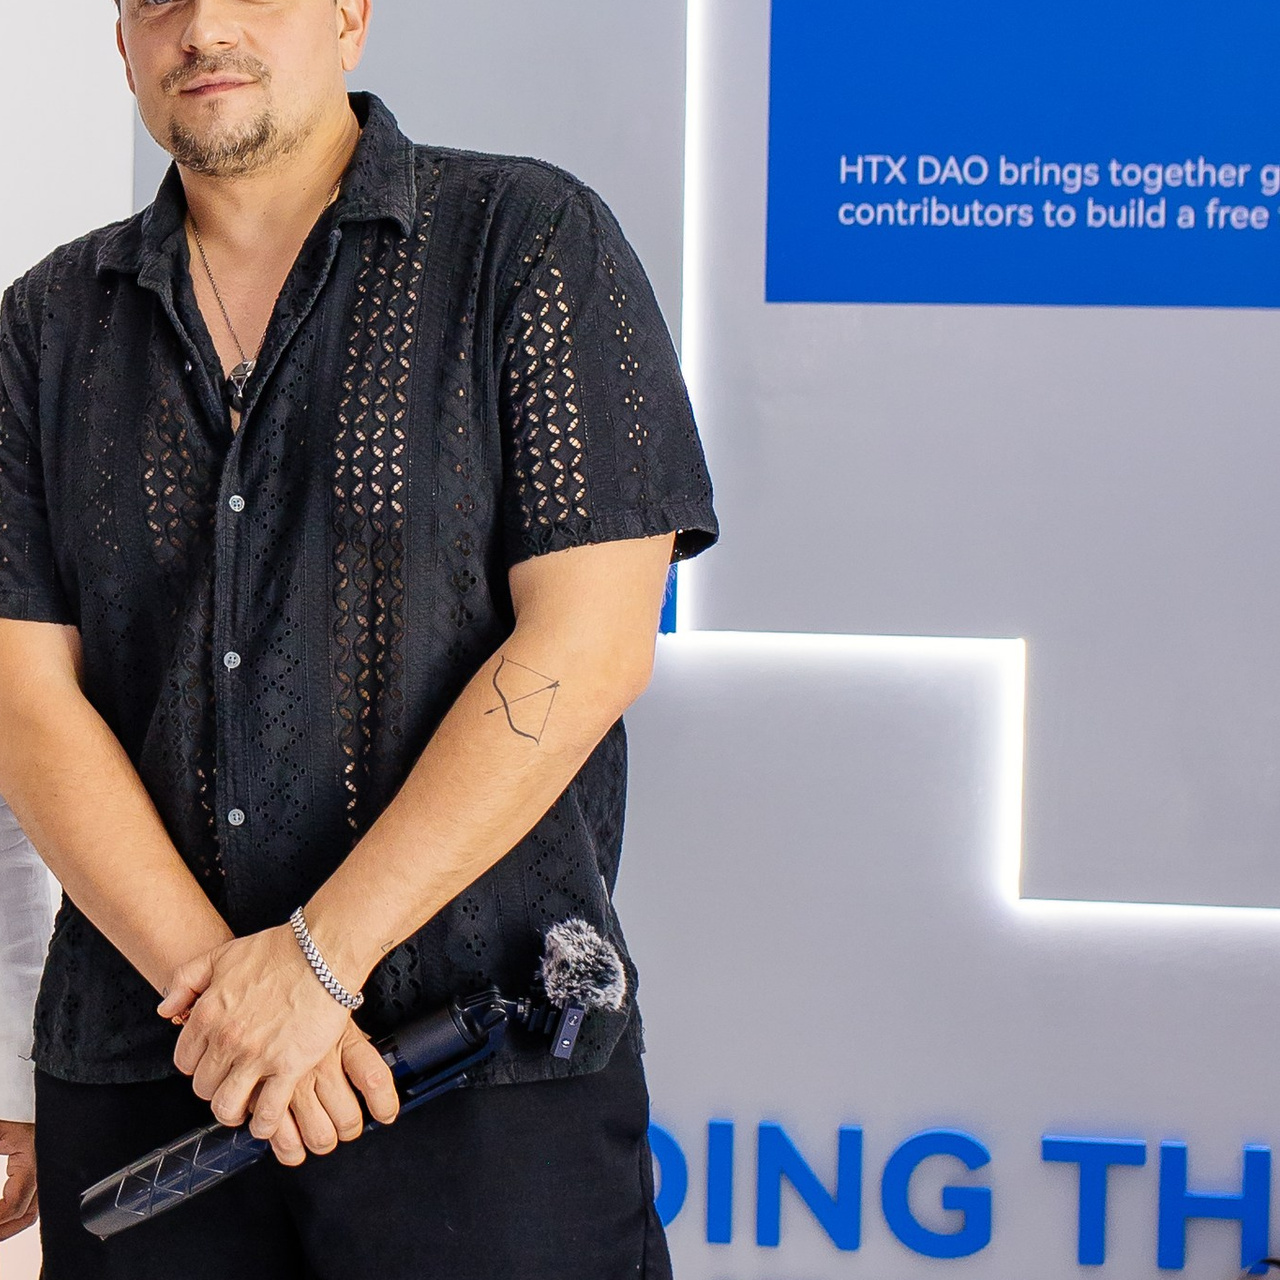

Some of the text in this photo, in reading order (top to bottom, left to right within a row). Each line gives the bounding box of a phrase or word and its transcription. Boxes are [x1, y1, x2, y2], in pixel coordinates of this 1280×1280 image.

[839, 156, 908, 186] HTX
[917, 156, 989, 186] DAO
[999, 155, 1100, 193] brings
[1108, 155, 1252, 195] together
[837, 196, 1270, 230] contributors to build a free
[1041, 1134, 1272, 1275] TH
